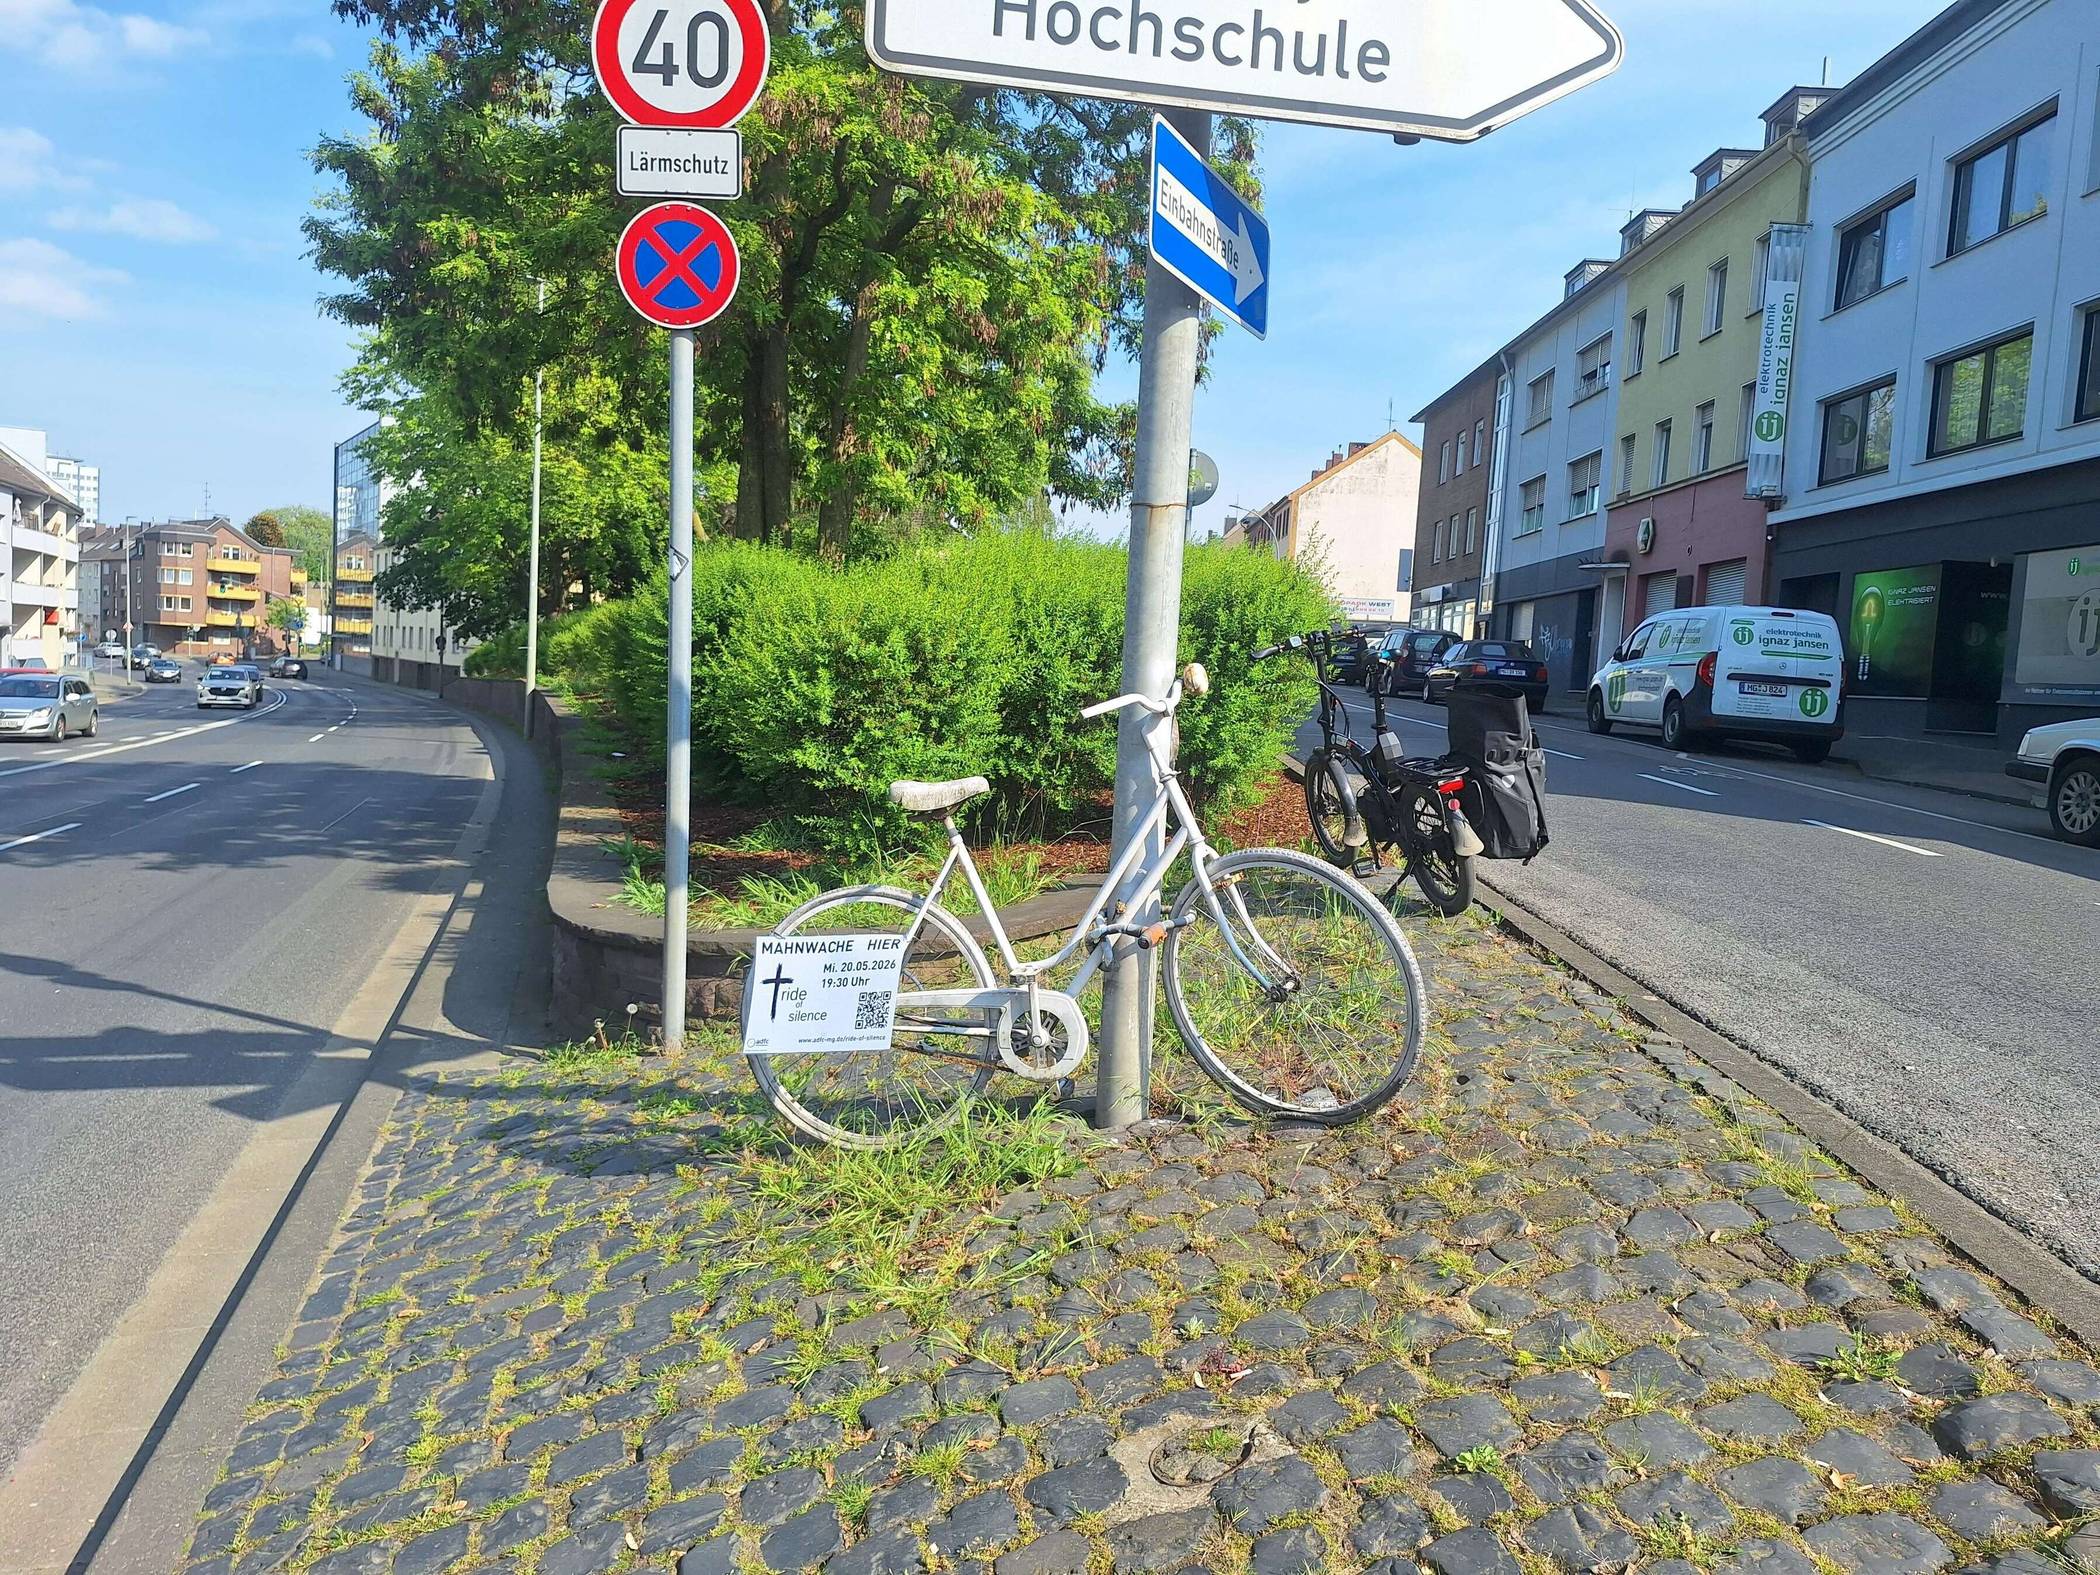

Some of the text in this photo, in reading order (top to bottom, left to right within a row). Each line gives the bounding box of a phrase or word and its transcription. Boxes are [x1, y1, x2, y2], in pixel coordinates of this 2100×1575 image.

[632, 9, 729, 89] 40
[992, 0, 1391, 84] Hochschule
[630, 151, 729, 175] Lärmschutz
[1760, 303, 1777, 394] elektrotechnik
[1765, 628, 1823, 639] elektrotechnik
[1758, 634, 1829, 650] ignaz jansen
[761, 938, 901, 955] MAHNWACHE HIER
[823, 959, 896, 974] Mi. 20.05.2026
[822, 976, 870, 988] 19:30 Uhr
[781, 987, 808, 1001] ride
[795, 1000, 803, 1008] of
[787, 1010, 828, 1022] silence
